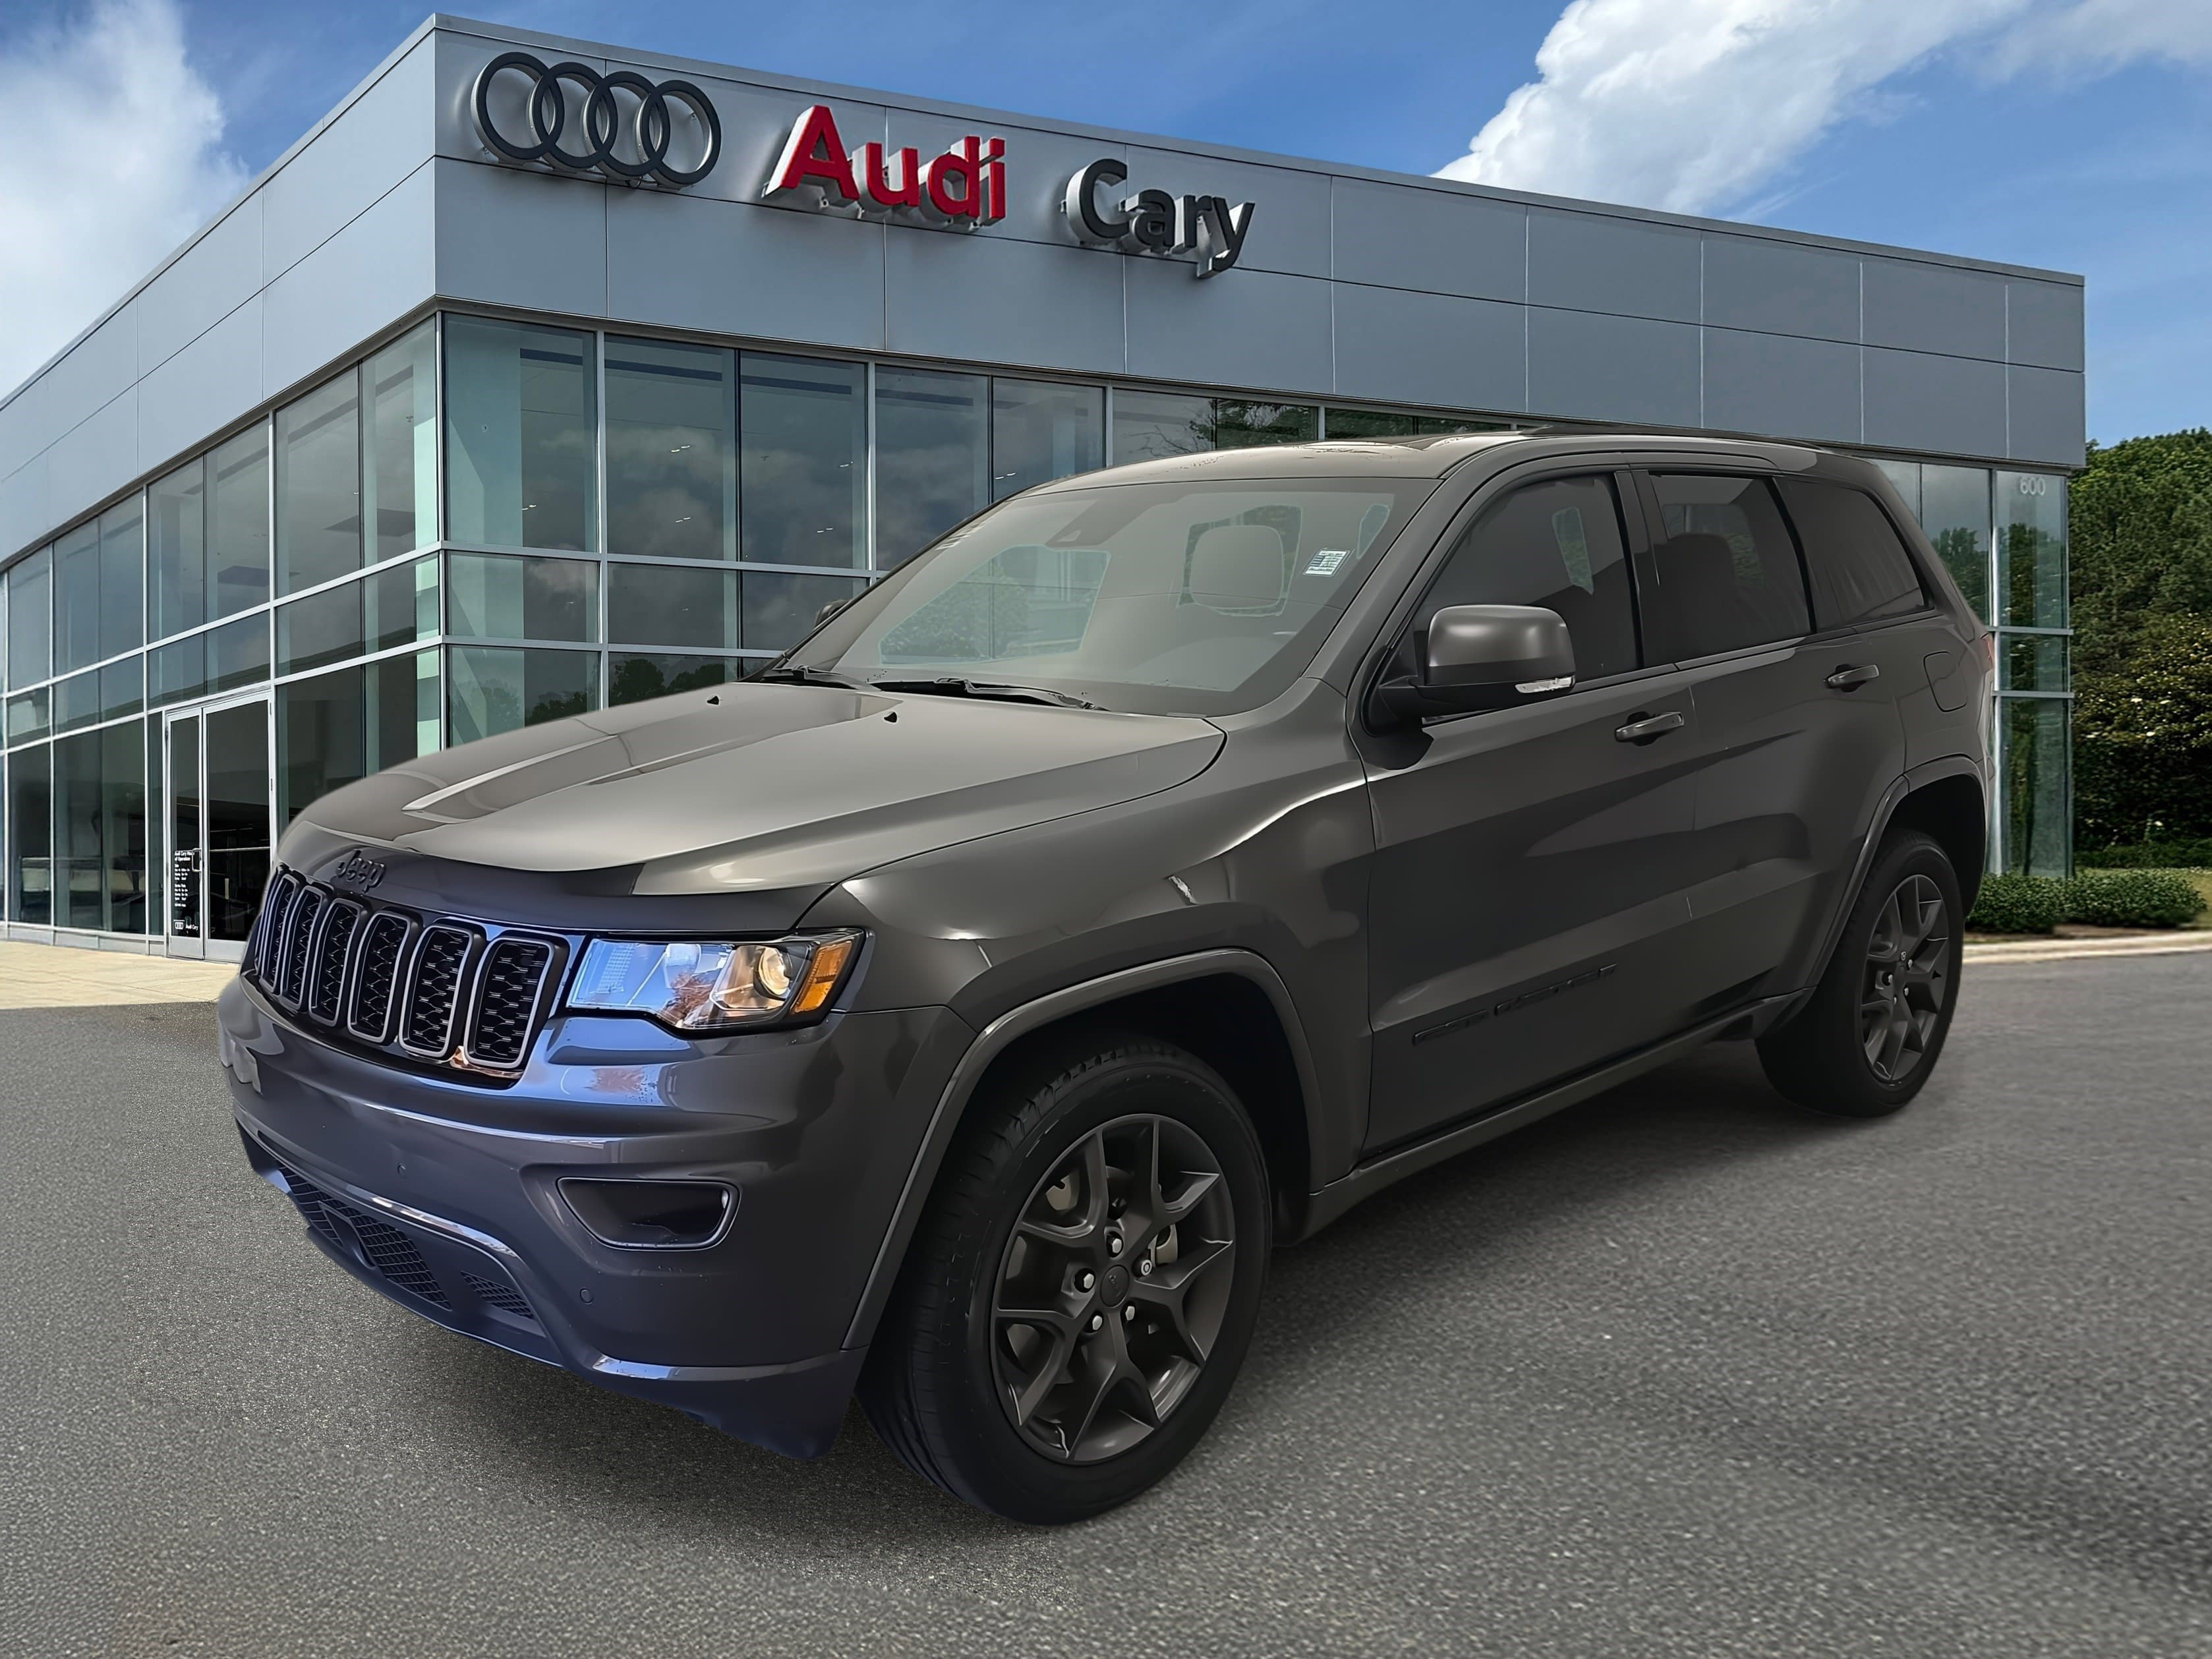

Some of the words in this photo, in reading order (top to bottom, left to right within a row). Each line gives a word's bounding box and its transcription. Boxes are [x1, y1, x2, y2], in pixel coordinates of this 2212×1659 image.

[766, 104, 1006, 226] Audi
[1062, 158, 1255, 279] Cary
[2020, 477, 2046, 496] 600
[335, 850, 386, 894] Jeep
